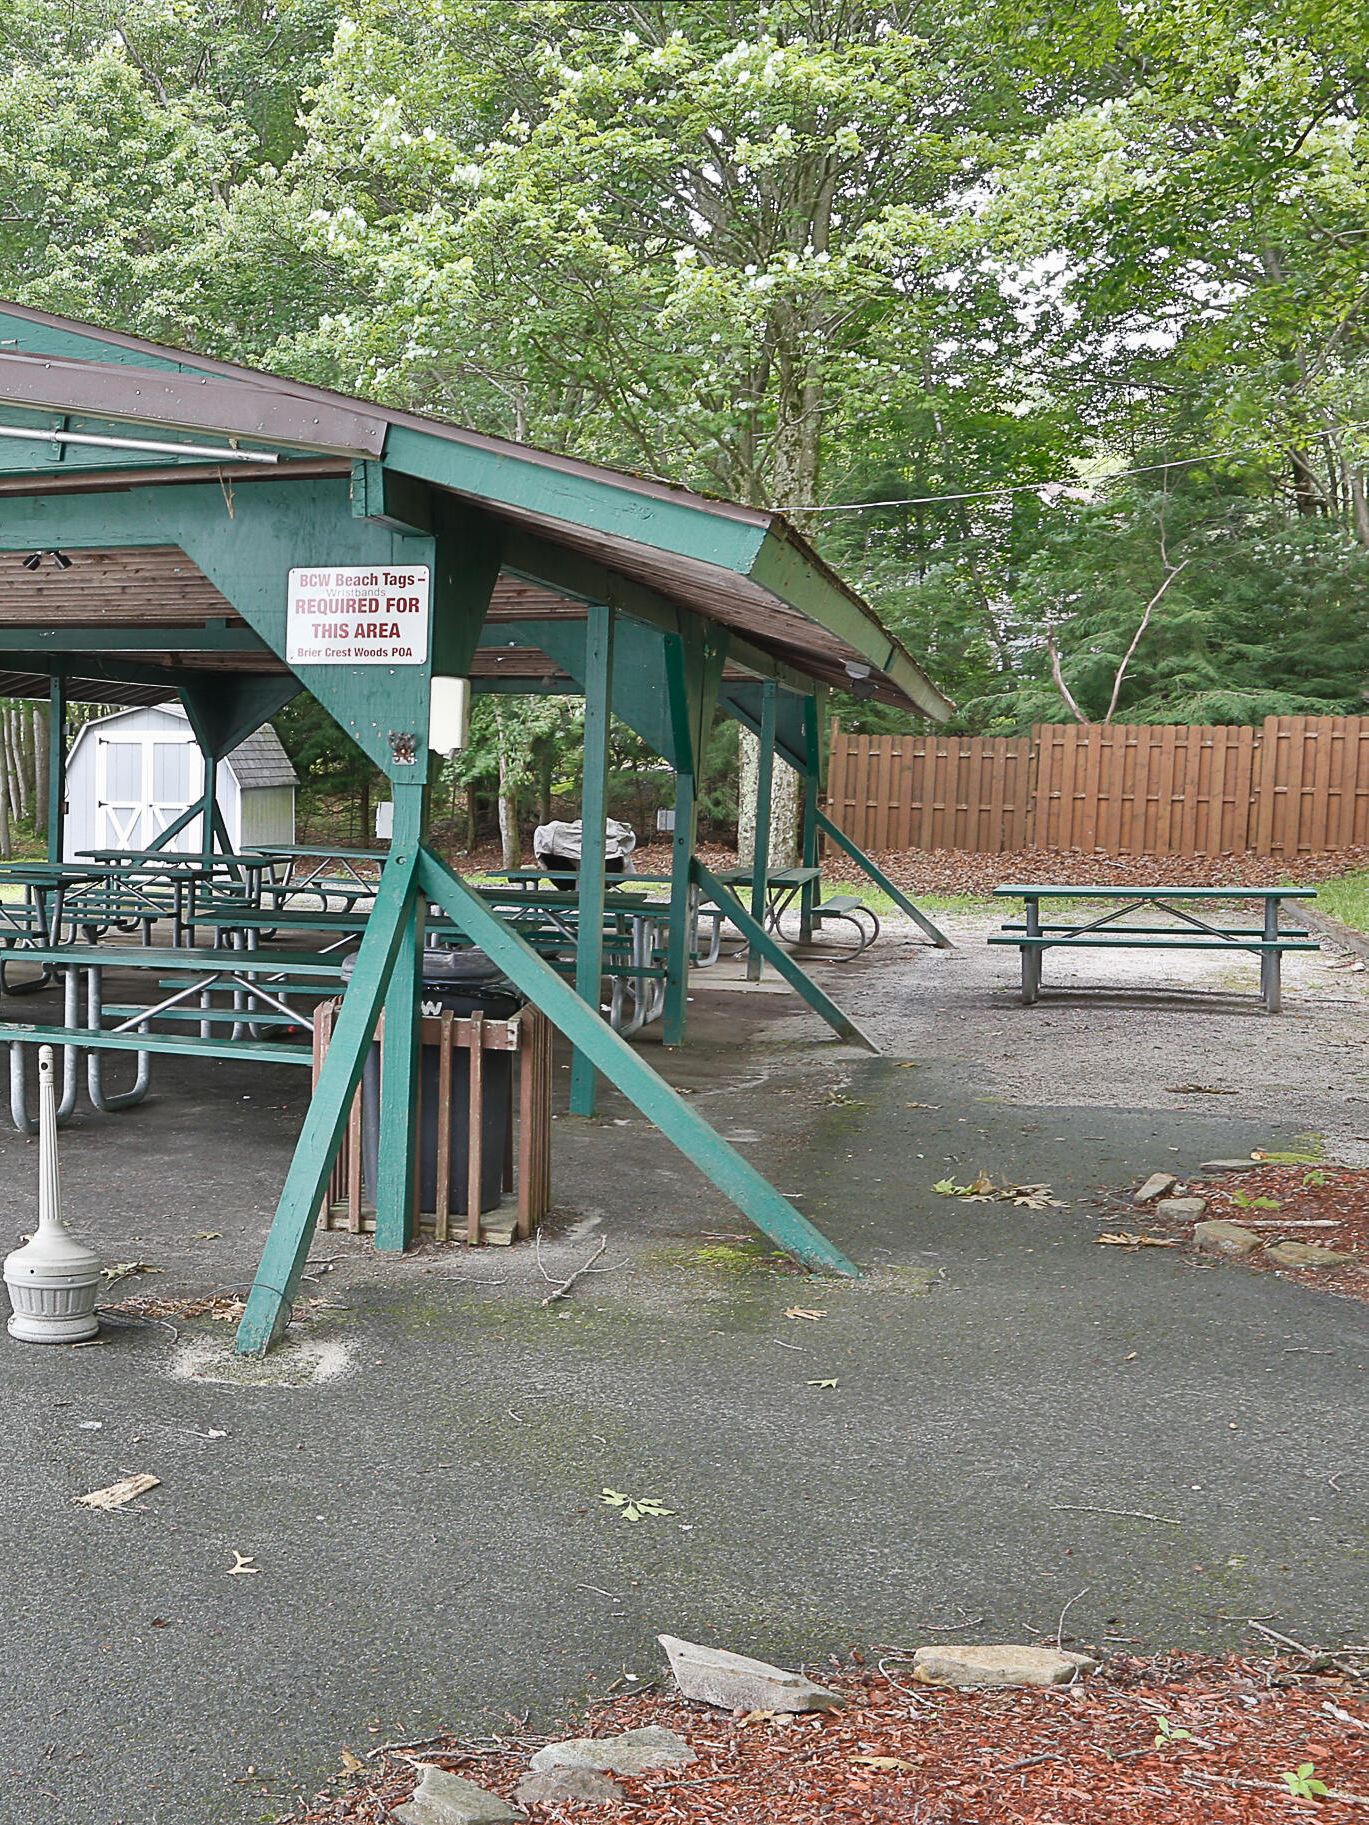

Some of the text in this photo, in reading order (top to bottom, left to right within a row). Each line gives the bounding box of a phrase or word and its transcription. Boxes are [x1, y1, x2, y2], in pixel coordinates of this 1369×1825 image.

[300, 574, 331, 587] BCW
[335, 573, 379, 586] Beach
[382, 572, 415, 588] Tags
[295, 597, 420, 615] REQUIRED FOR
[312, 622, 401, 639] THIS AREA
[297, 647, 413, 657] Brier Crest Woods POA
